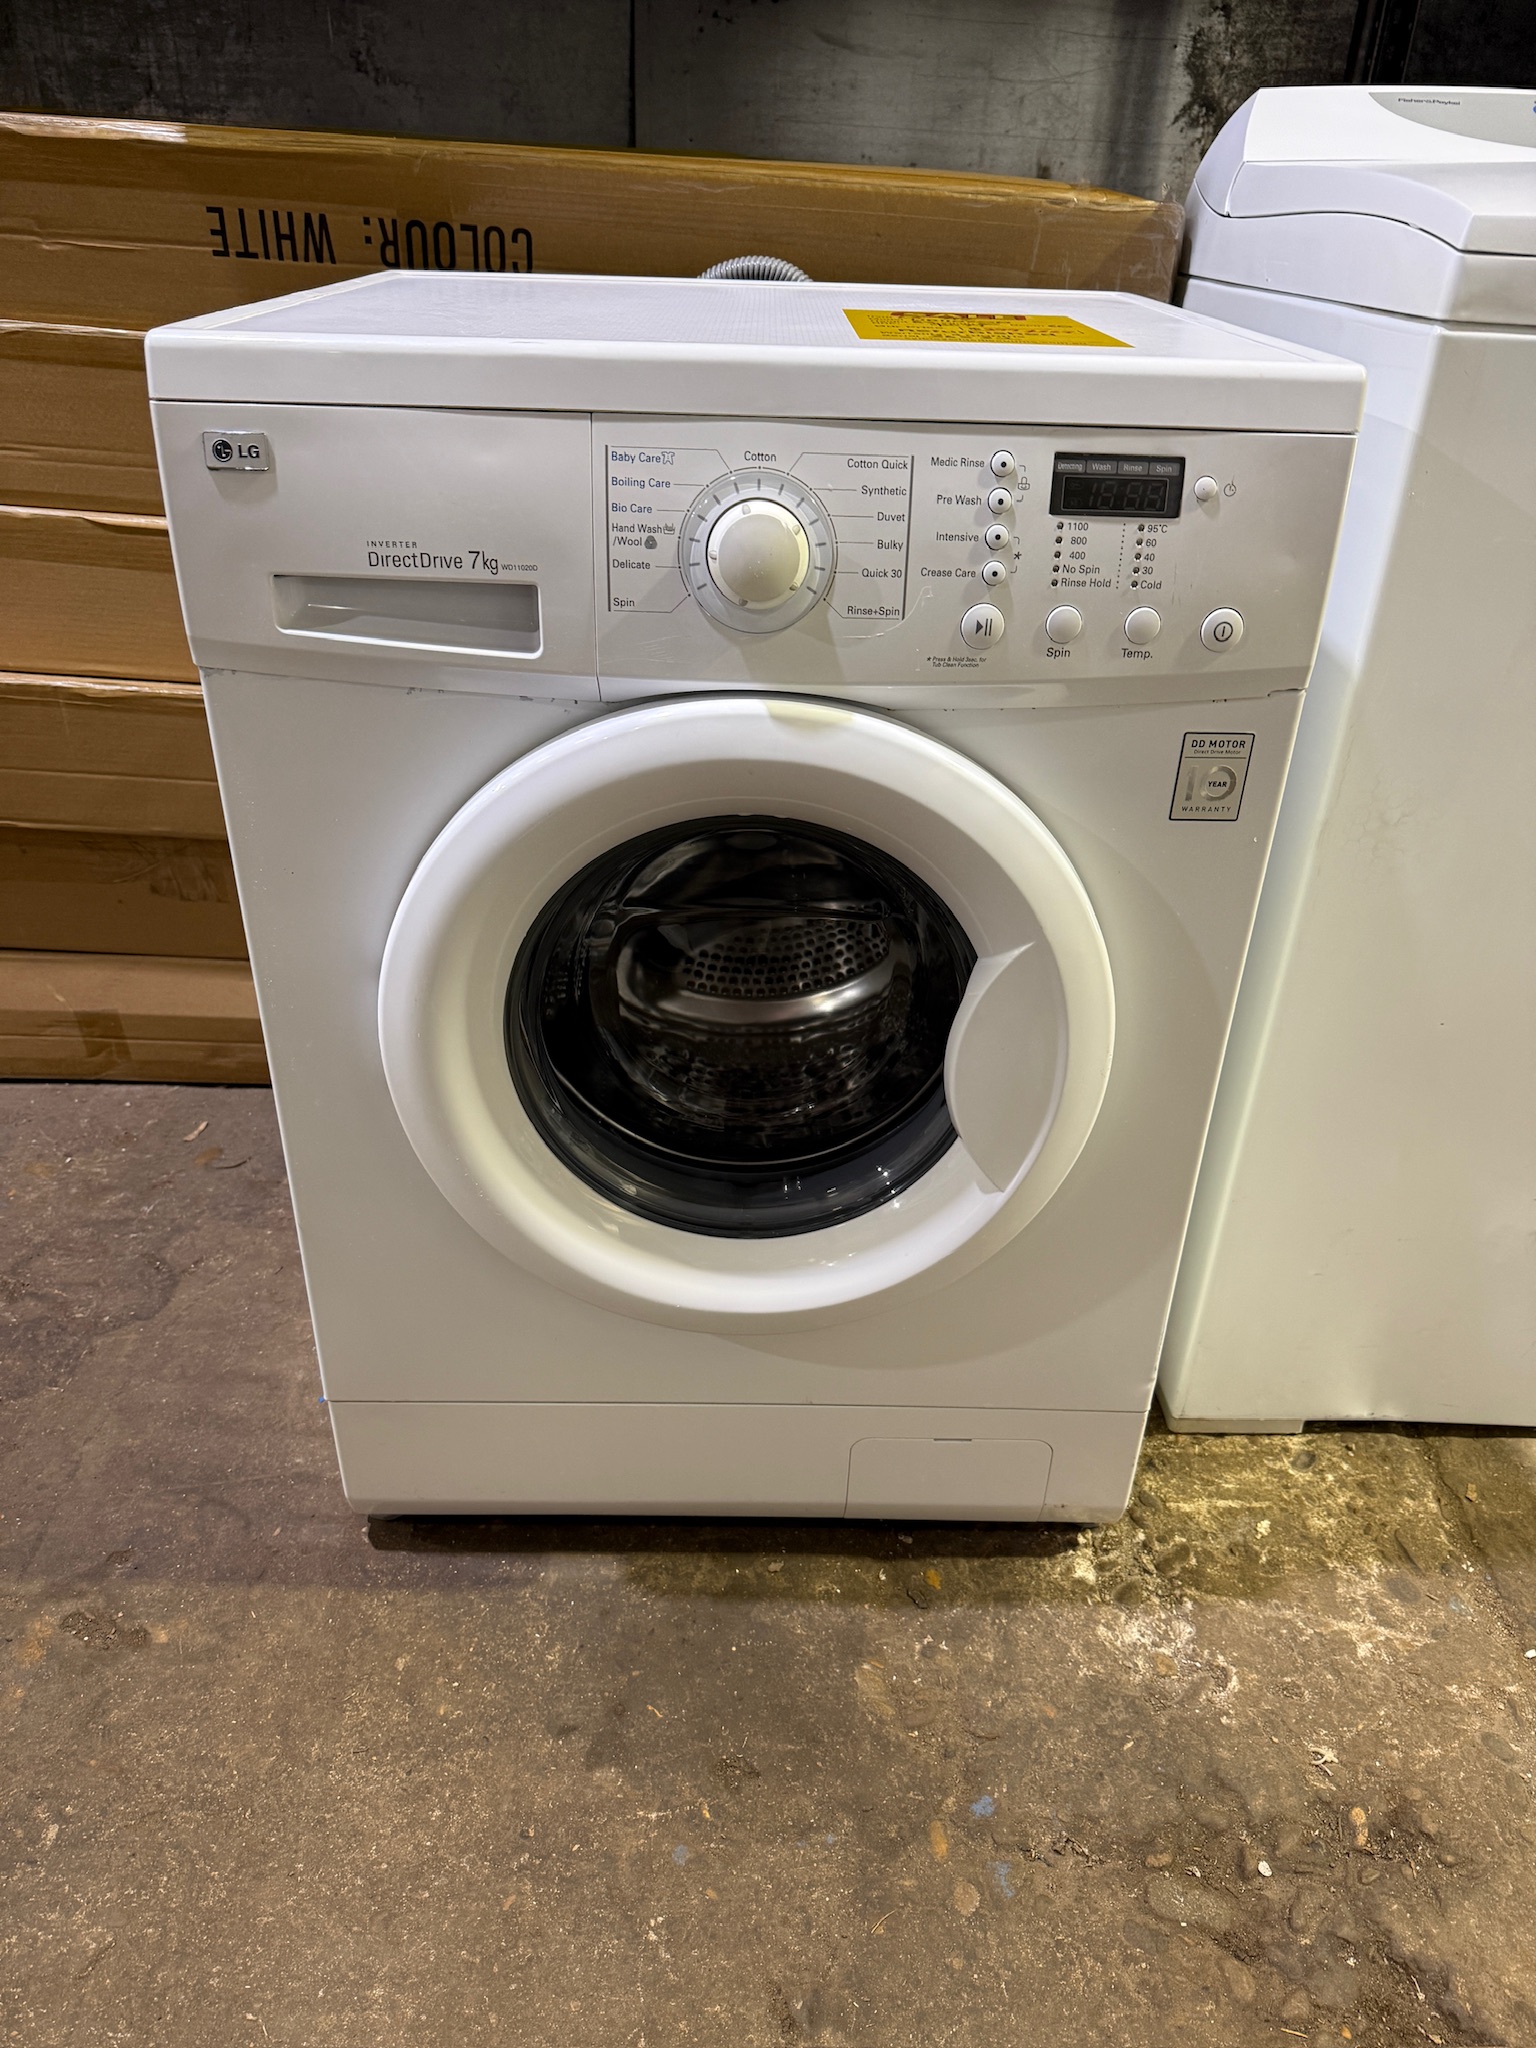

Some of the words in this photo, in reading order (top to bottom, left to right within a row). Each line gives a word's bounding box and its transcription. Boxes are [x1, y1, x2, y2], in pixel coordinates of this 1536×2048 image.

[206, 206, 336, 265] WHITE
[363, 217, 533, 273] COLOUR:
[237, 443, 260, 459] LG
[744, 450, 777, 462] Cotton
[611, 451, 637, 464] Baby
[638, 453, 662, 464] Care
[930, 456, 957, 468] Medic
[959, 457, 985, 469] Rinse
[846, 458, 879, 470] Cotton
[880, 459, 908, 471] Quick
[1092, 463, 1112, 471] Wash
[1123, 464, 1143, 472] Rinse
[1155, 464, 1173, 474] Spin
[611, 477, 645, 489] Boiling
[647, 478, 671, 489] Care
[861, 484, 907, 497] Synthetic
[936, 495, 953, 505] Pre
[955, 495, 982, 506] Wash
[611, 503, 630, 514] Bio
[631, 504, 653, 514] Care
[877, 511, 906, 522] Duvet
[612, 523, 634, 534] Hand
[635, 524, 662, 534] Wash
[1068, 522, 1089, 531] 1100
[612, 536, 643, 548] /Wool
[936, 531, 979, 543] Intensive
[1070, 536, 1088, 545] 800
[1145, 538, 1157, 547] 60
[366, 540, 418, 549] INVERTER
[877, 539, 904, 551] Bulky
[1069, 551, 1086, 560] 400
[1143, 553, 1155, 561] 40
[468, 550, 499, 575] 7kg
[500, 563, 539, 572] WD11020D
[612, 559, 651, 570] Delicate
[861, 568, 886, 580] Quick
[887, 568, 902, 579] 30
[920, 567, 953, 579] Crease
[955, 568, 976, 579] Care
[1062, 564, 1077, 574] No
[1079, 565, 1100, 576] Spin
[1142, 566, 1154, 575] 30
[1061, 578, 1087, 587] Rinse
[1089, 578, 1112, 588] Hold
[1140, 580, 1162, 590] Cold
[613, 597, 635, 608] Spin
[846, 605, 900, 617] Rinse+Spin
[1046, 647, 1071, 659] Spin
[1121, 648, 1153, 660] Temp.
[1191, 739, 1206, 748] DD
[1208, 740, 1246, 749] MOTOR
[1185, 764, 1237, 801] 10
[1208, 780, 1228, 788] YEAR
